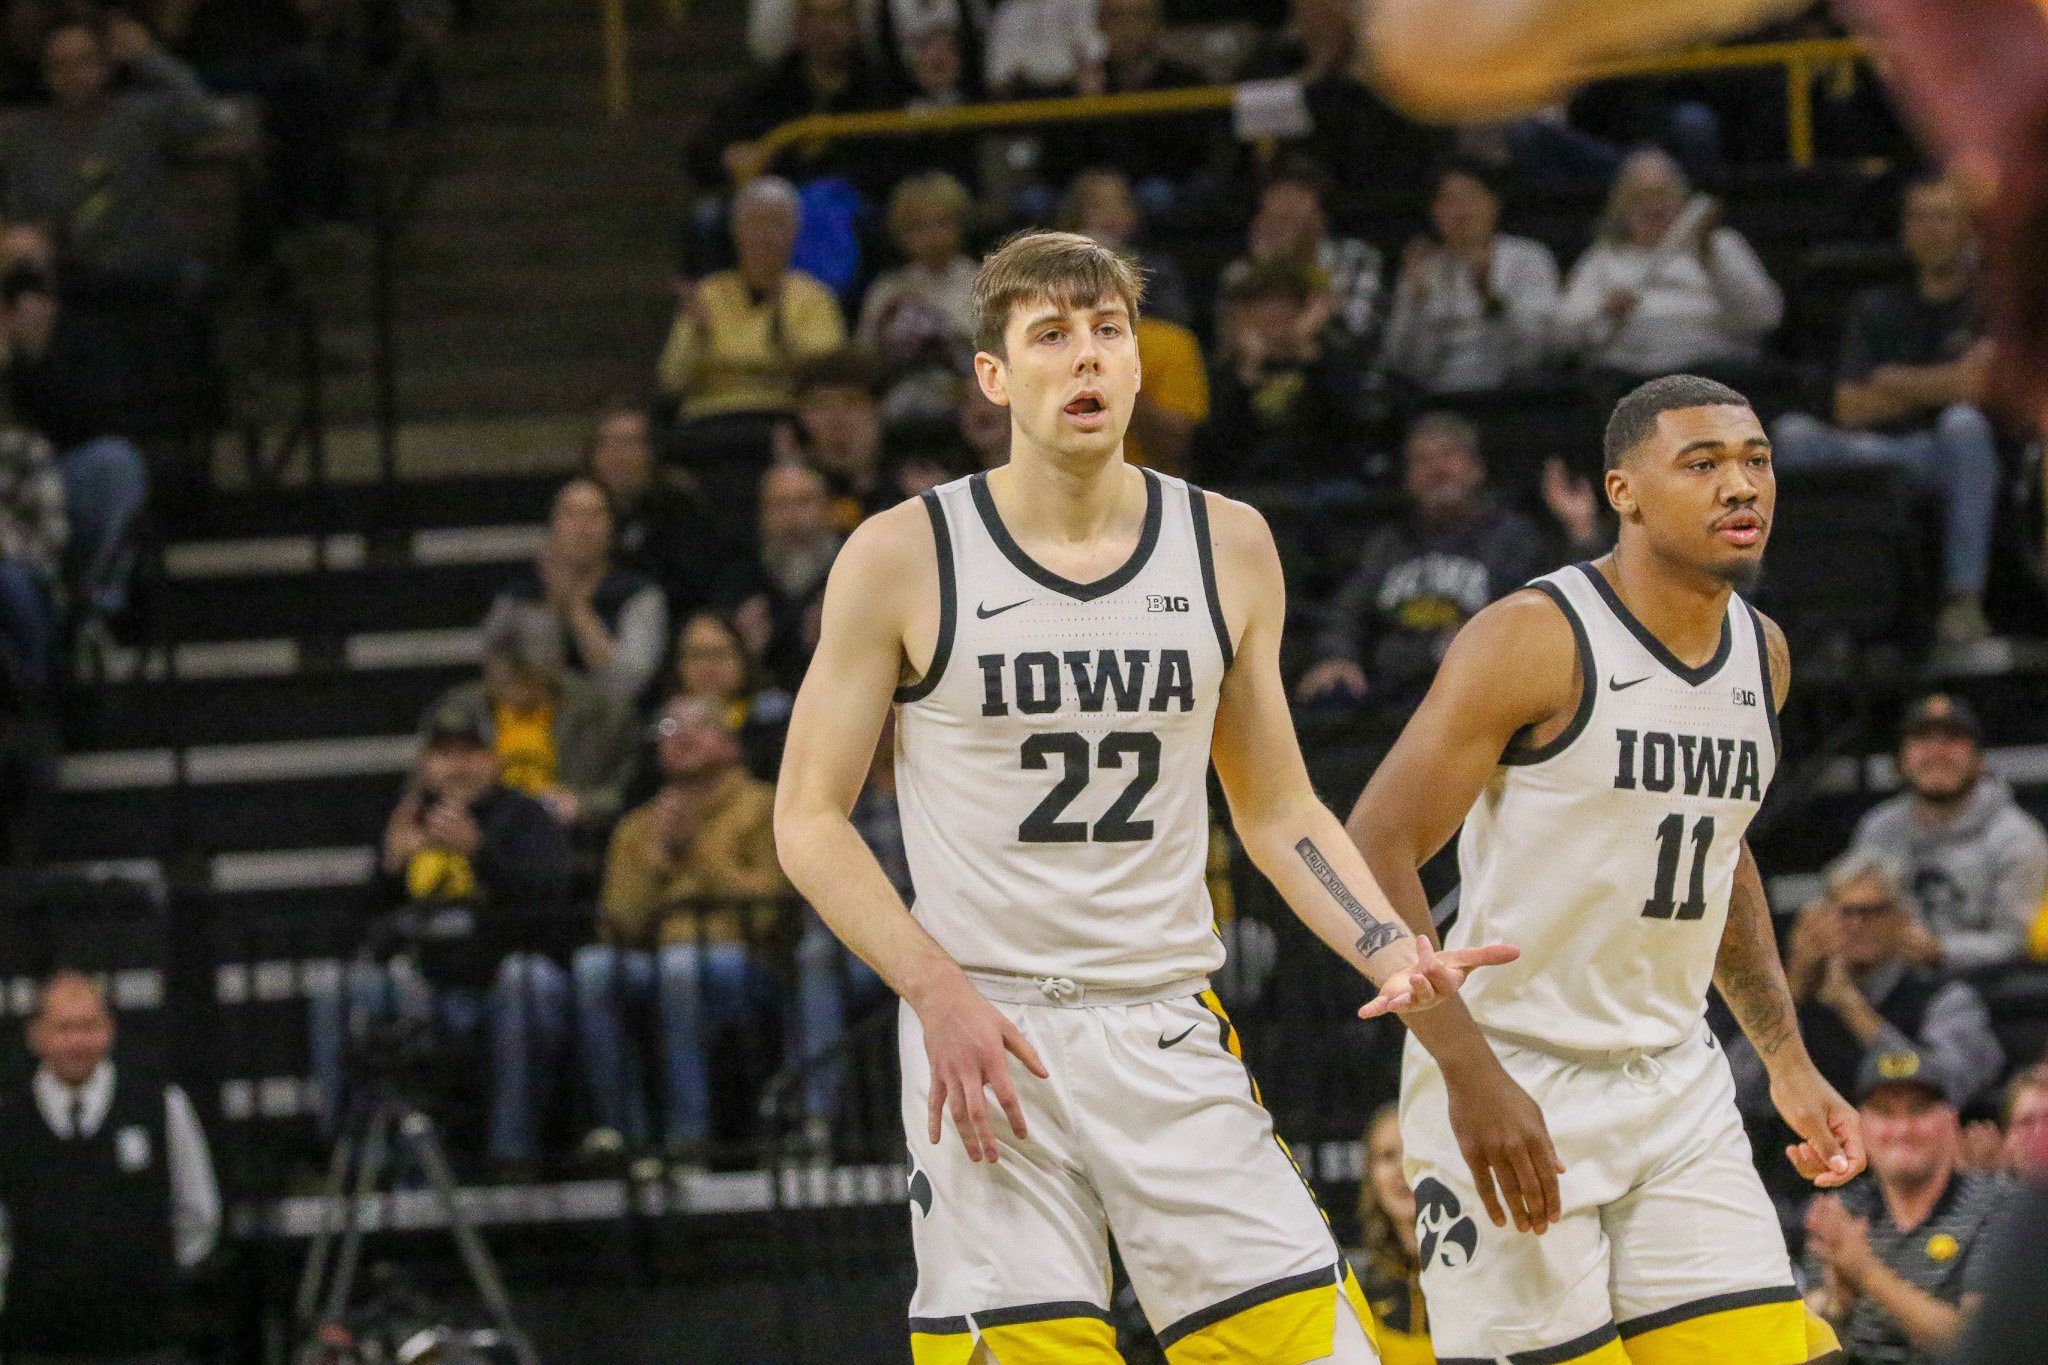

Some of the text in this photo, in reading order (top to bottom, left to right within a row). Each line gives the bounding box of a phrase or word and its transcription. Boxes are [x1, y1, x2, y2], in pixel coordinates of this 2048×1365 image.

[977, 649, 1196, 717] IOWA
[1018, 731, 1162, 843] 22
[1614, 728, 1761, 803] IOWA
[1306, 850, 1372, 925] TRUST YOUR WORK
[1641, 813, 1715, 921] 11
